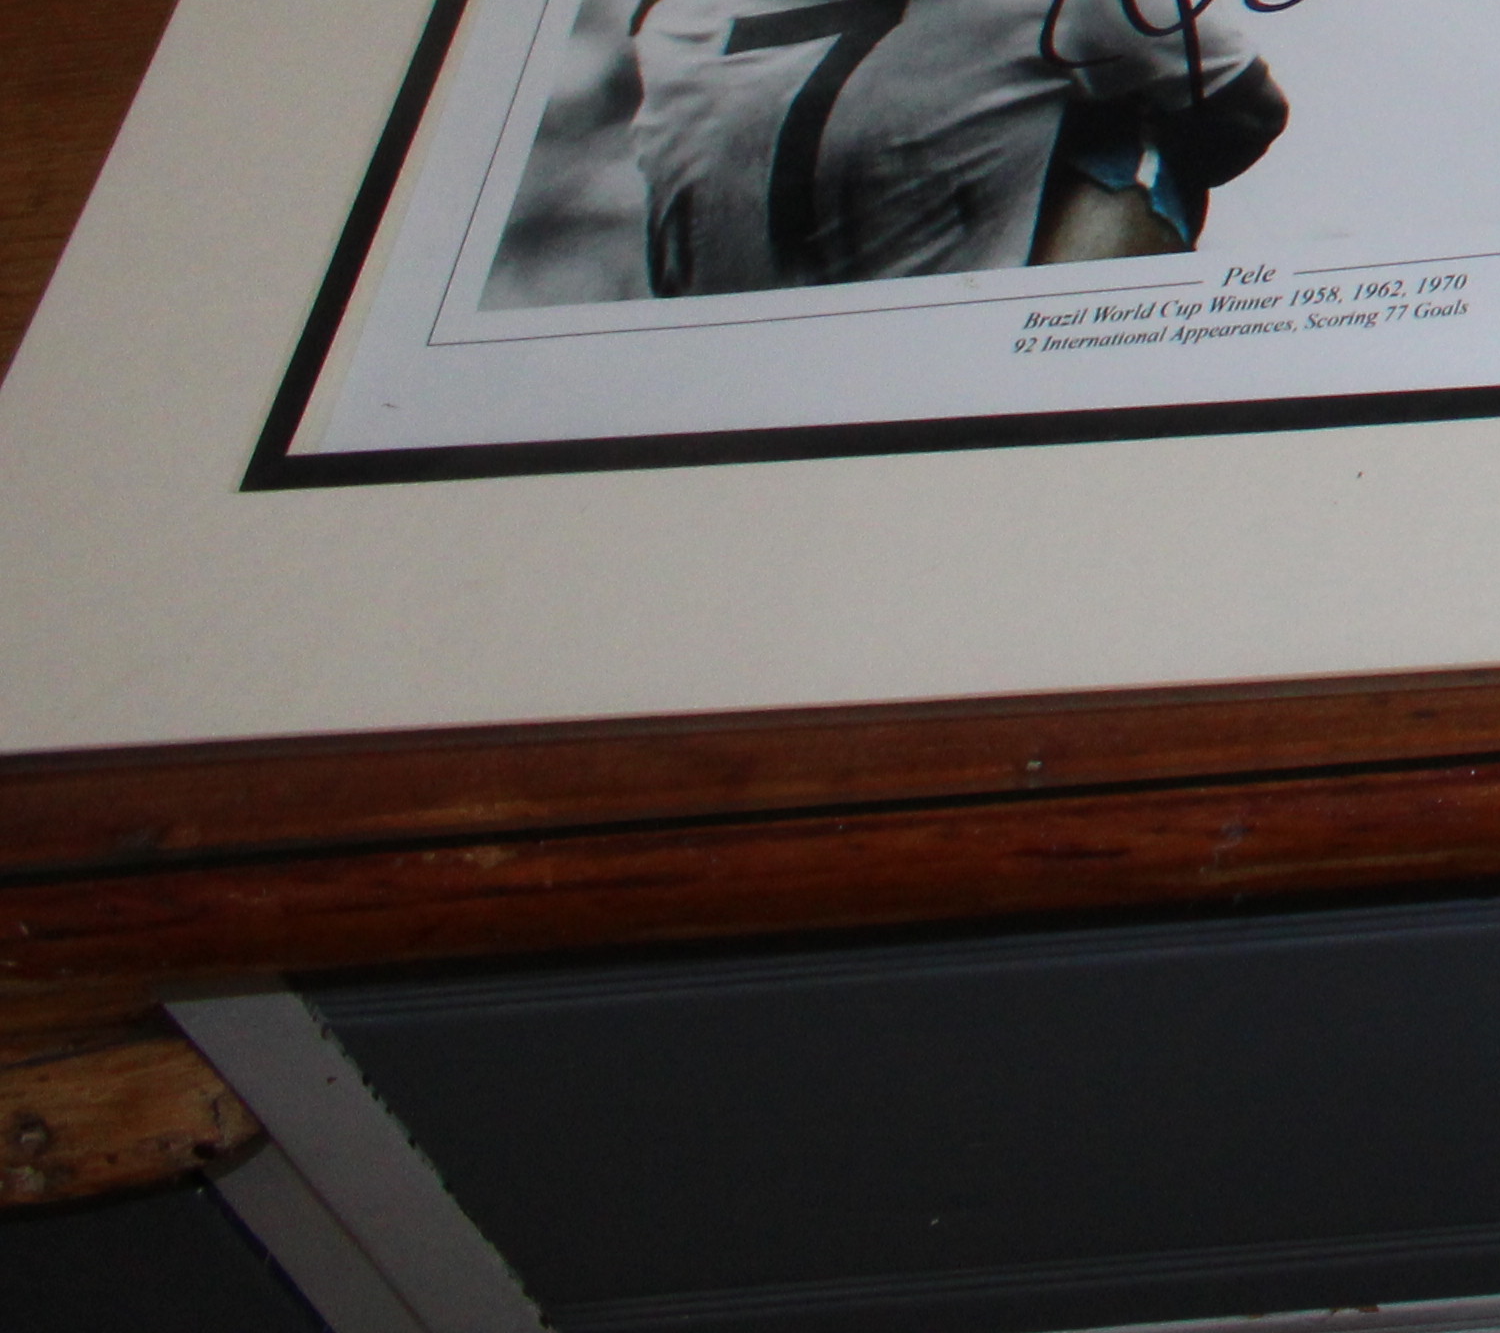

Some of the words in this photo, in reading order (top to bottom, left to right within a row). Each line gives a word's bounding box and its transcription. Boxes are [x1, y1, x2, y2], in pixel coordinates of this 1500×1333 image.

[1023, 308, 1088, 330] Brazil
[1092, 301, 1156, 324] World
[1160, 299, 1202, 320] Cup
[1208, 293, 1284, 314] Winner
[1289, 284, 1344, 307] 1958,
[1352, 279, 1407, 301] 1962,
[1416, 274, 1468, 295] 1970
[1221, 263, 1277, 286] Pele
[1013, 336, 1038, 354] 92
[1041, 326, 1168, 352] International
[1170, 318, 1298, 345] Appearances,
[1303, 309, 1380, 330] Scoring
[1383, 304, 1409, 322] 77
[1413, 299, 1469, 319] Goals
